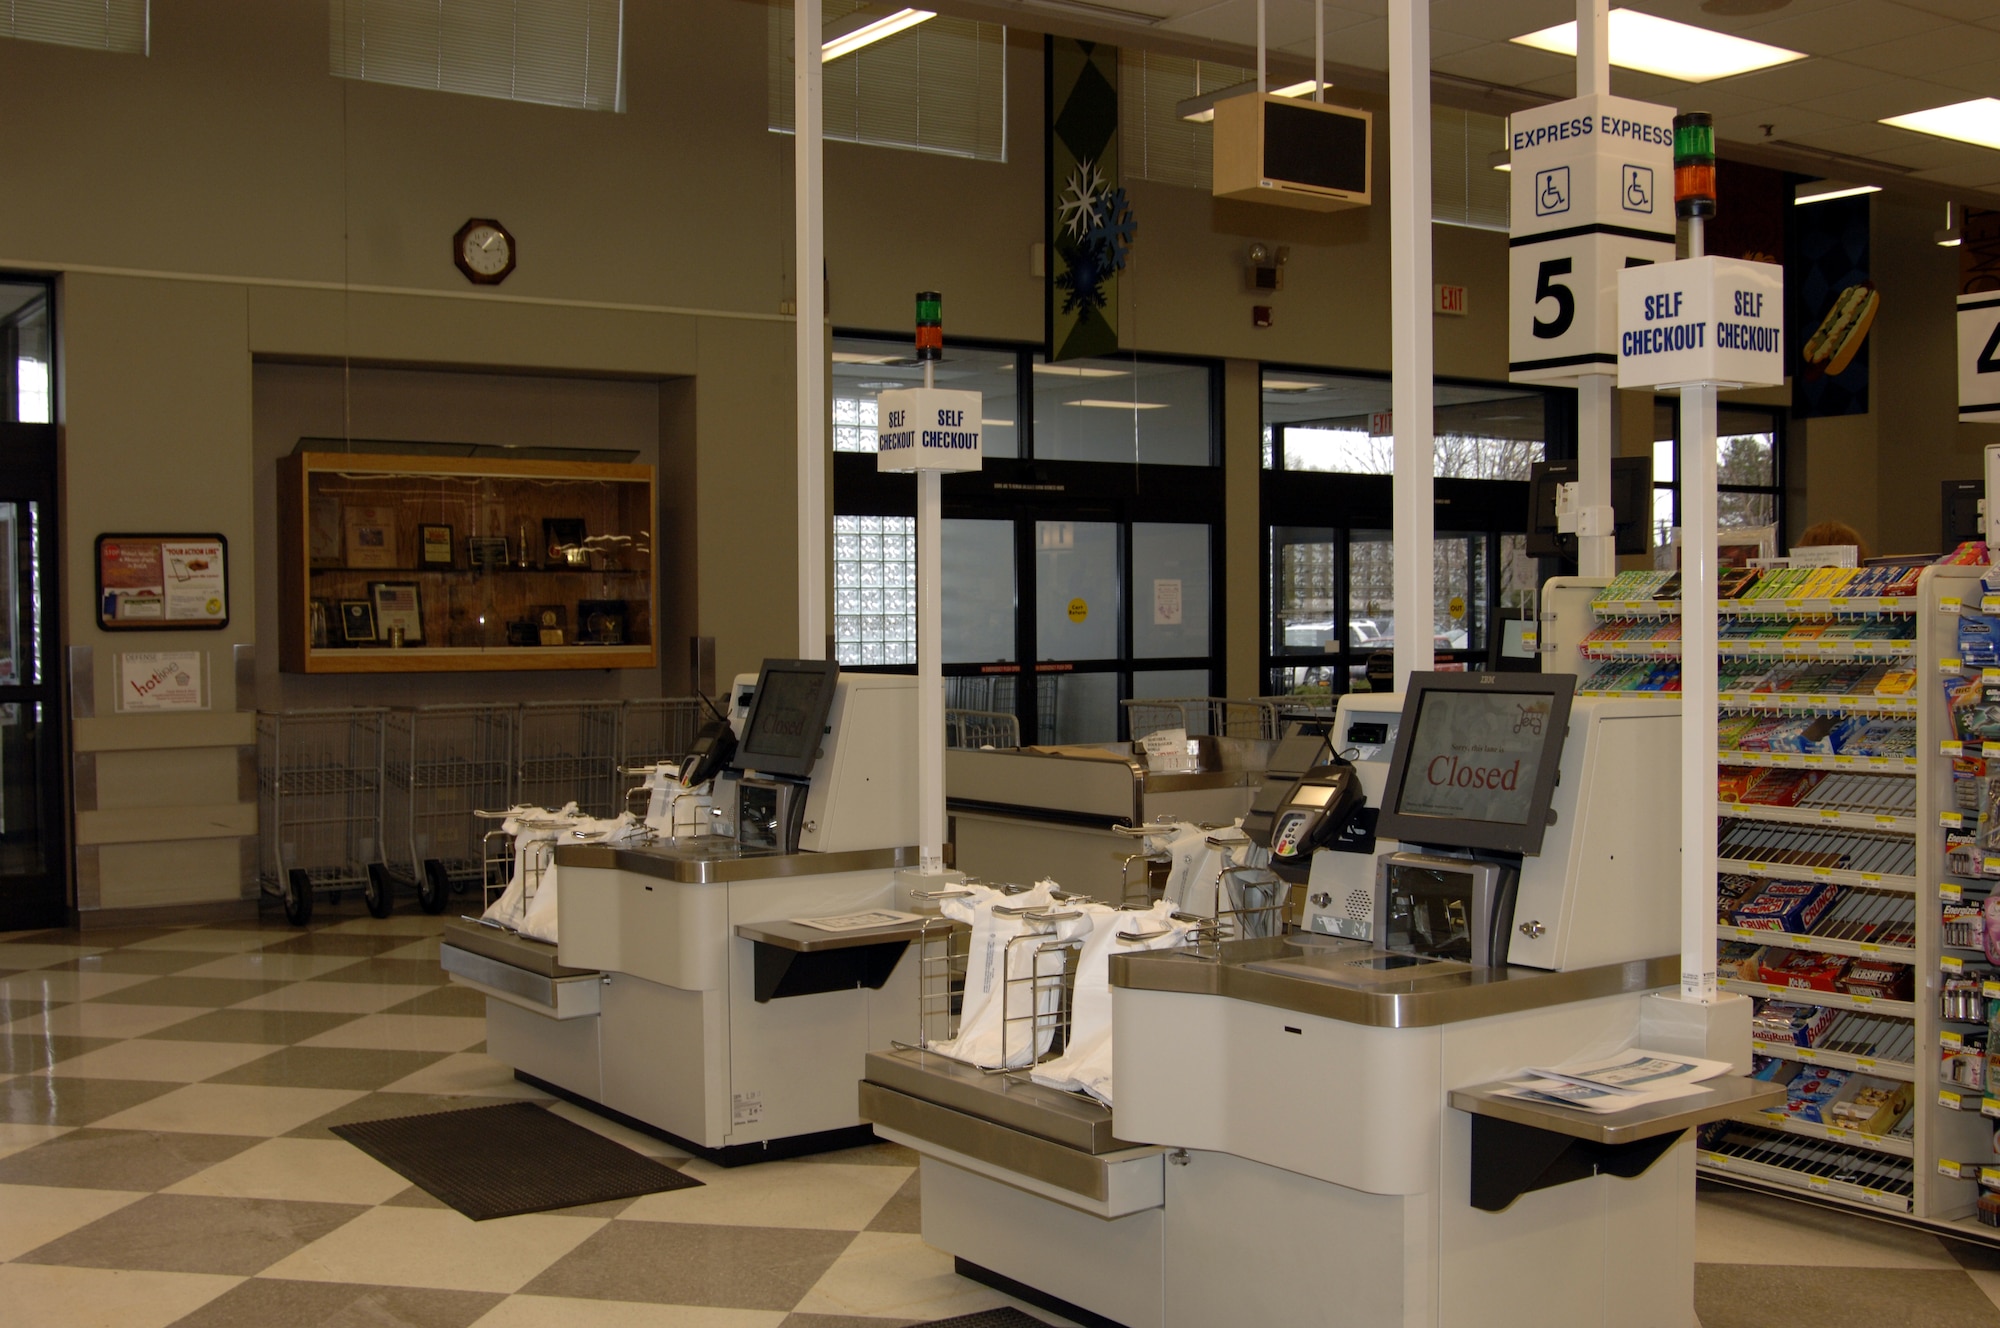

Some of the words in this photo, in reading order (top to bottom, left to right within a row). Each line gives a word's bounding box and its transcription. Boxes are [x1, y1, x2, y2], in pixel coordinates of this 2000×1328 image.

[1514, 116, 1593, 150] EXPRESS
[1601, 115, 1673, 147] EXPRESS
[1441, 285, 1463, 312] EXIT
[1533, 256, 1575, 339] 5
[1644, 292, 1683, 321] SELF
[1734, 290, 1763, 318] SELF
[1622, 322, 1706, 357] CHECKOUT
[1717, 322, 1780, 353] CHECKOUT
[888, 410, 906, 428] SELF
[938, 409, 964, 427] SELF
[1373, 412, 1393, 435] EXIT
[880, 430, 915, 451] CHECKOUT
[922, 430, 979, 450] CHECKOUT
[130, 662, 179, 697] hotline
[1480, 675, 1496, 684] IBM
[762, 713, 807, 736] Closed
[1451, 743, 1470, 752] Sorry,
[1427, 755, 1521, 791] Closed
[1767, 884, 1813, 895] CRUNCH
[1803, 884, 1837, 927] CRUNCH
[1943, 904, 1979, 916] Energizer
[1739, 919, 1782, 931] CRUNCH
[1850, 967, 1895, 983] HERSHEY'S
